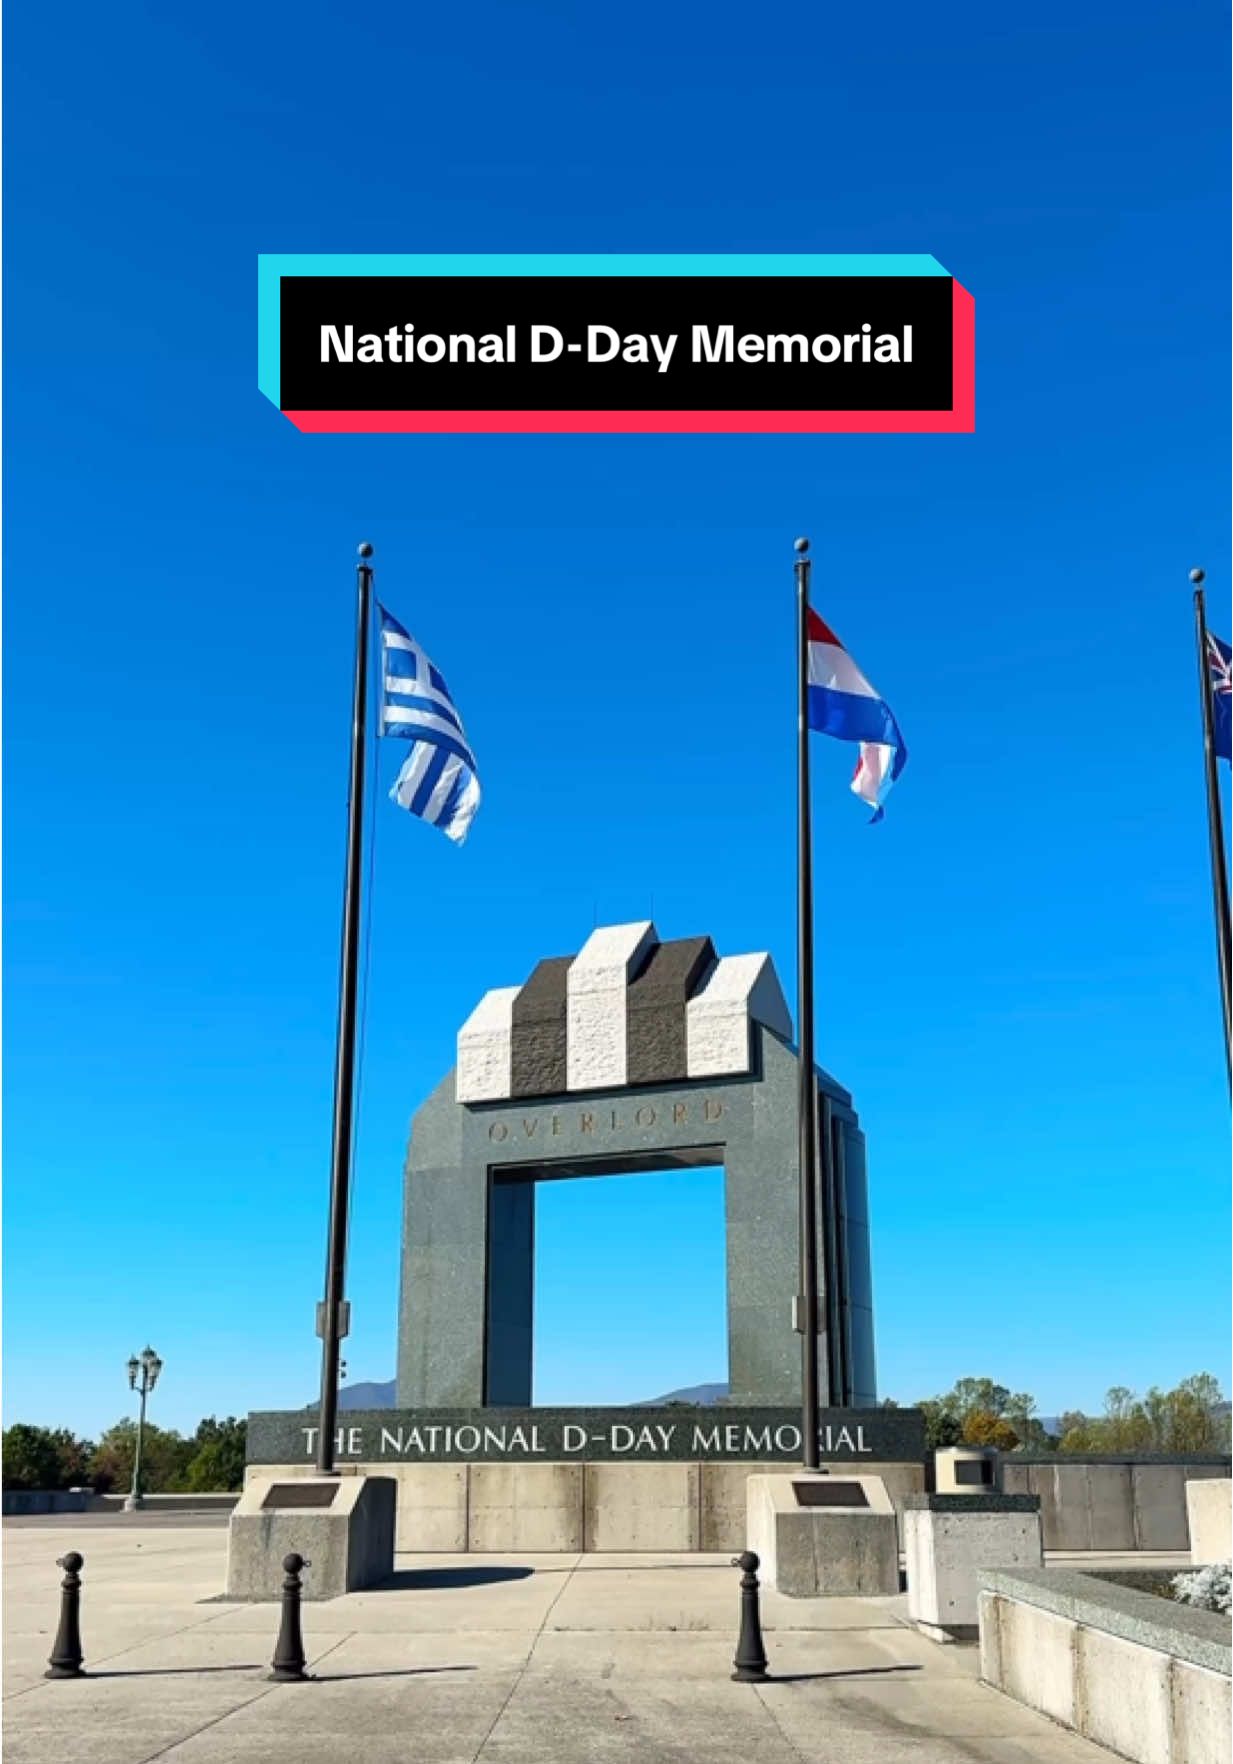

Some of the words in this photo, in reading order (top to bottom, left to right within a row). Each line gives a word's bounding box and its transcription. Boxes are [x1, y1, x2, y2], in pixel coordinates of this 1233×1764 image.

[488, 1098, 725, 1143] OVERLORD
[381, 1425, 546, 1453] NATIONAL
[563, 1425, 673, 1452] D-DAY
[691, 1425, 873, 1452] MEMOIAL
